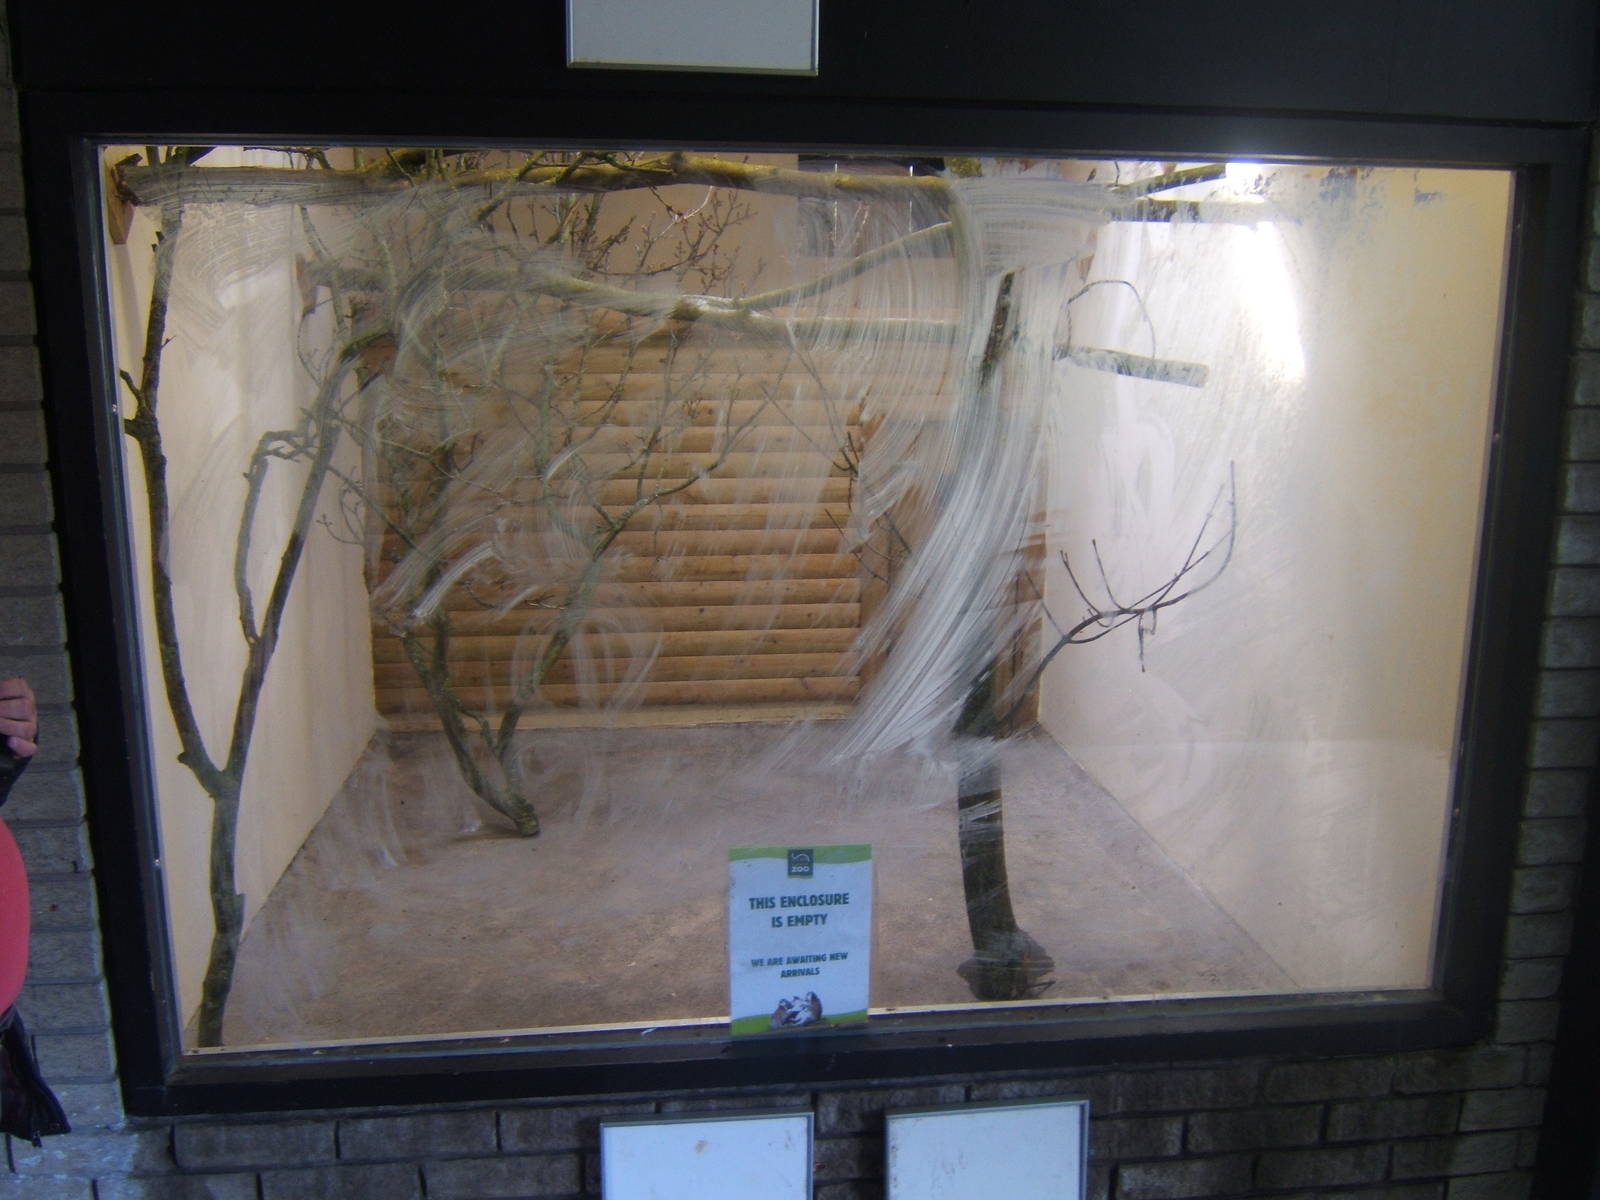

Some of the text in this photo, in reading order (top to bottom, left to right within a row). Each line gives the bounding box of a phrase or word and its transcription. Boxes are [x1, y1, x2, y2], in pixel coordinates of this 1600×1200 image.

[748, 893, 849, 910] THIS ENCLOSURE
[771, 914, 828, 928] IS EMPTY
[751, 952, 848, 968] WE ARE AWAITING NEW
[780, 967, 821, 978] ARRIVALS
